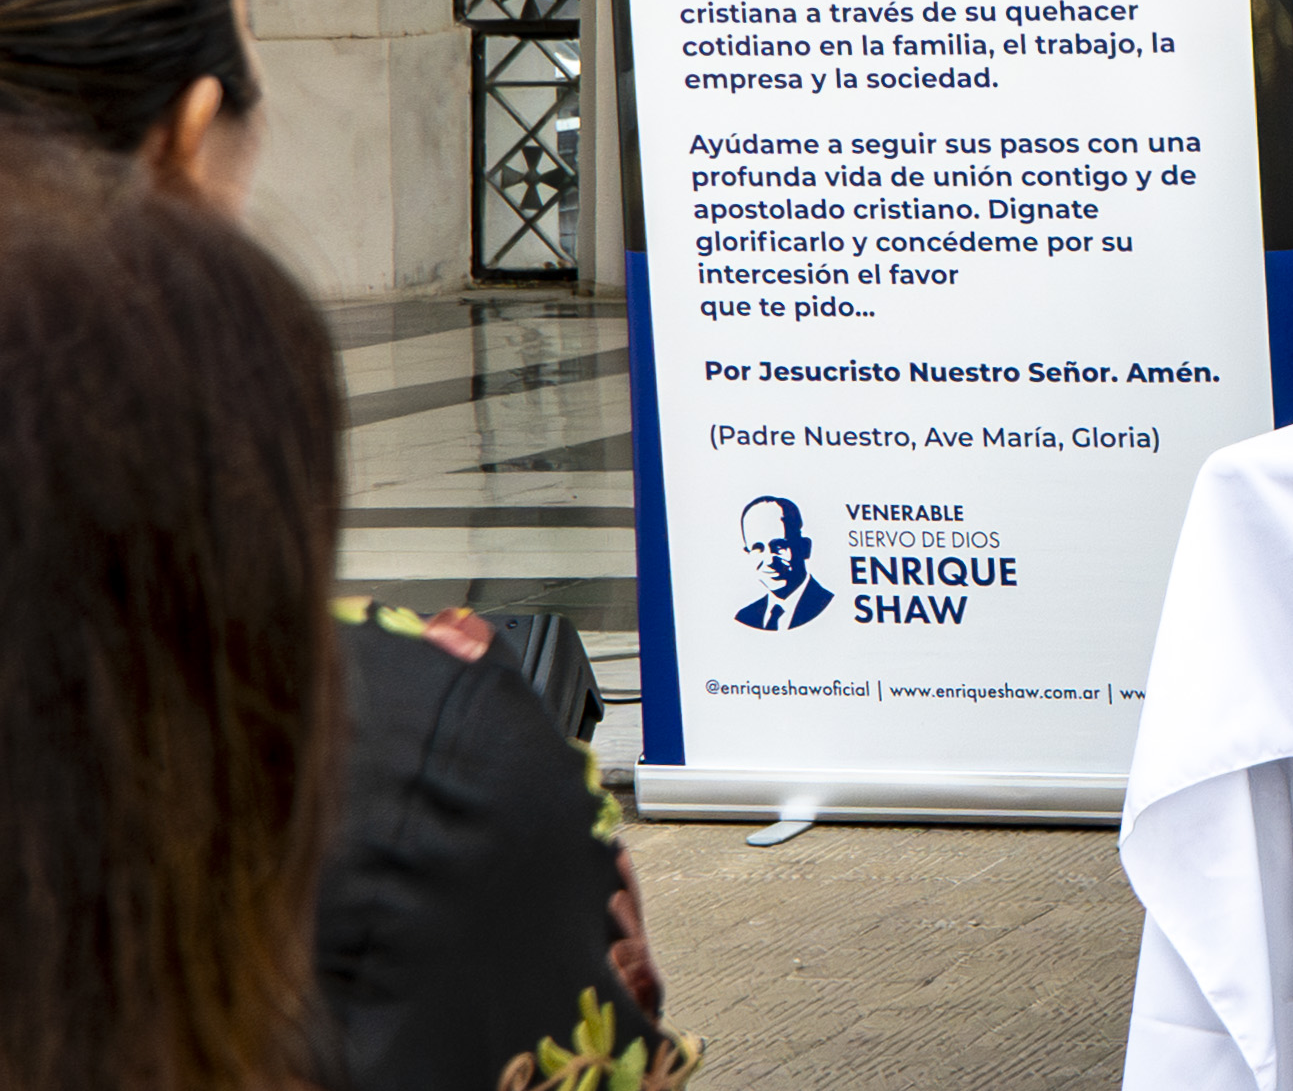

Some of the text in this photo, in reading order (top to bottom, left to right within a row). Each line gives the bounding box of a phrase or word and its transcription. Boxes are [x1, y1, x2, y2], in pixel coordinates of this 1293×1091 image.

[680, 0, 1139, 27] cristiana a través de su quehacer
[682, 31, 1175, 60] cotidiano en la familia, el trabajo, la
[684, 66, 999, 94] empresa y la sociedad.
[689, 131, 1201, 160] Ayúdame a seguir sus pasos con una
[692, 164, 1197, 192] profunda vida de unión contigo y de
[694, 197, 1099, 225] apostolado cristiano. Dignate
[695, 229, 1133, 258] glorificarlo y concédeme por su
[698, 262, 959, 285] intercesión el favor
[700, 294, 875, 322] que te pido...
[705, 359, 1220, 384] Por Jesucristo Nuestro Señor. Amén.
[710, 424, 1160, 454] (Padre Nuestro, Ave María, Gloria)
[845, 503, 964, 522] VENERABLE
[848, 530, 1000, 549] SIERVO DE DIOS
[850, 556, 1018, 587] ENRIQUE
[854, 594, 968, 625] SHAW
[706, 679, 870, 700] @enriqueshawoficial
[889, 682, 1101, 703] www.enriqueshaw.com.ar
